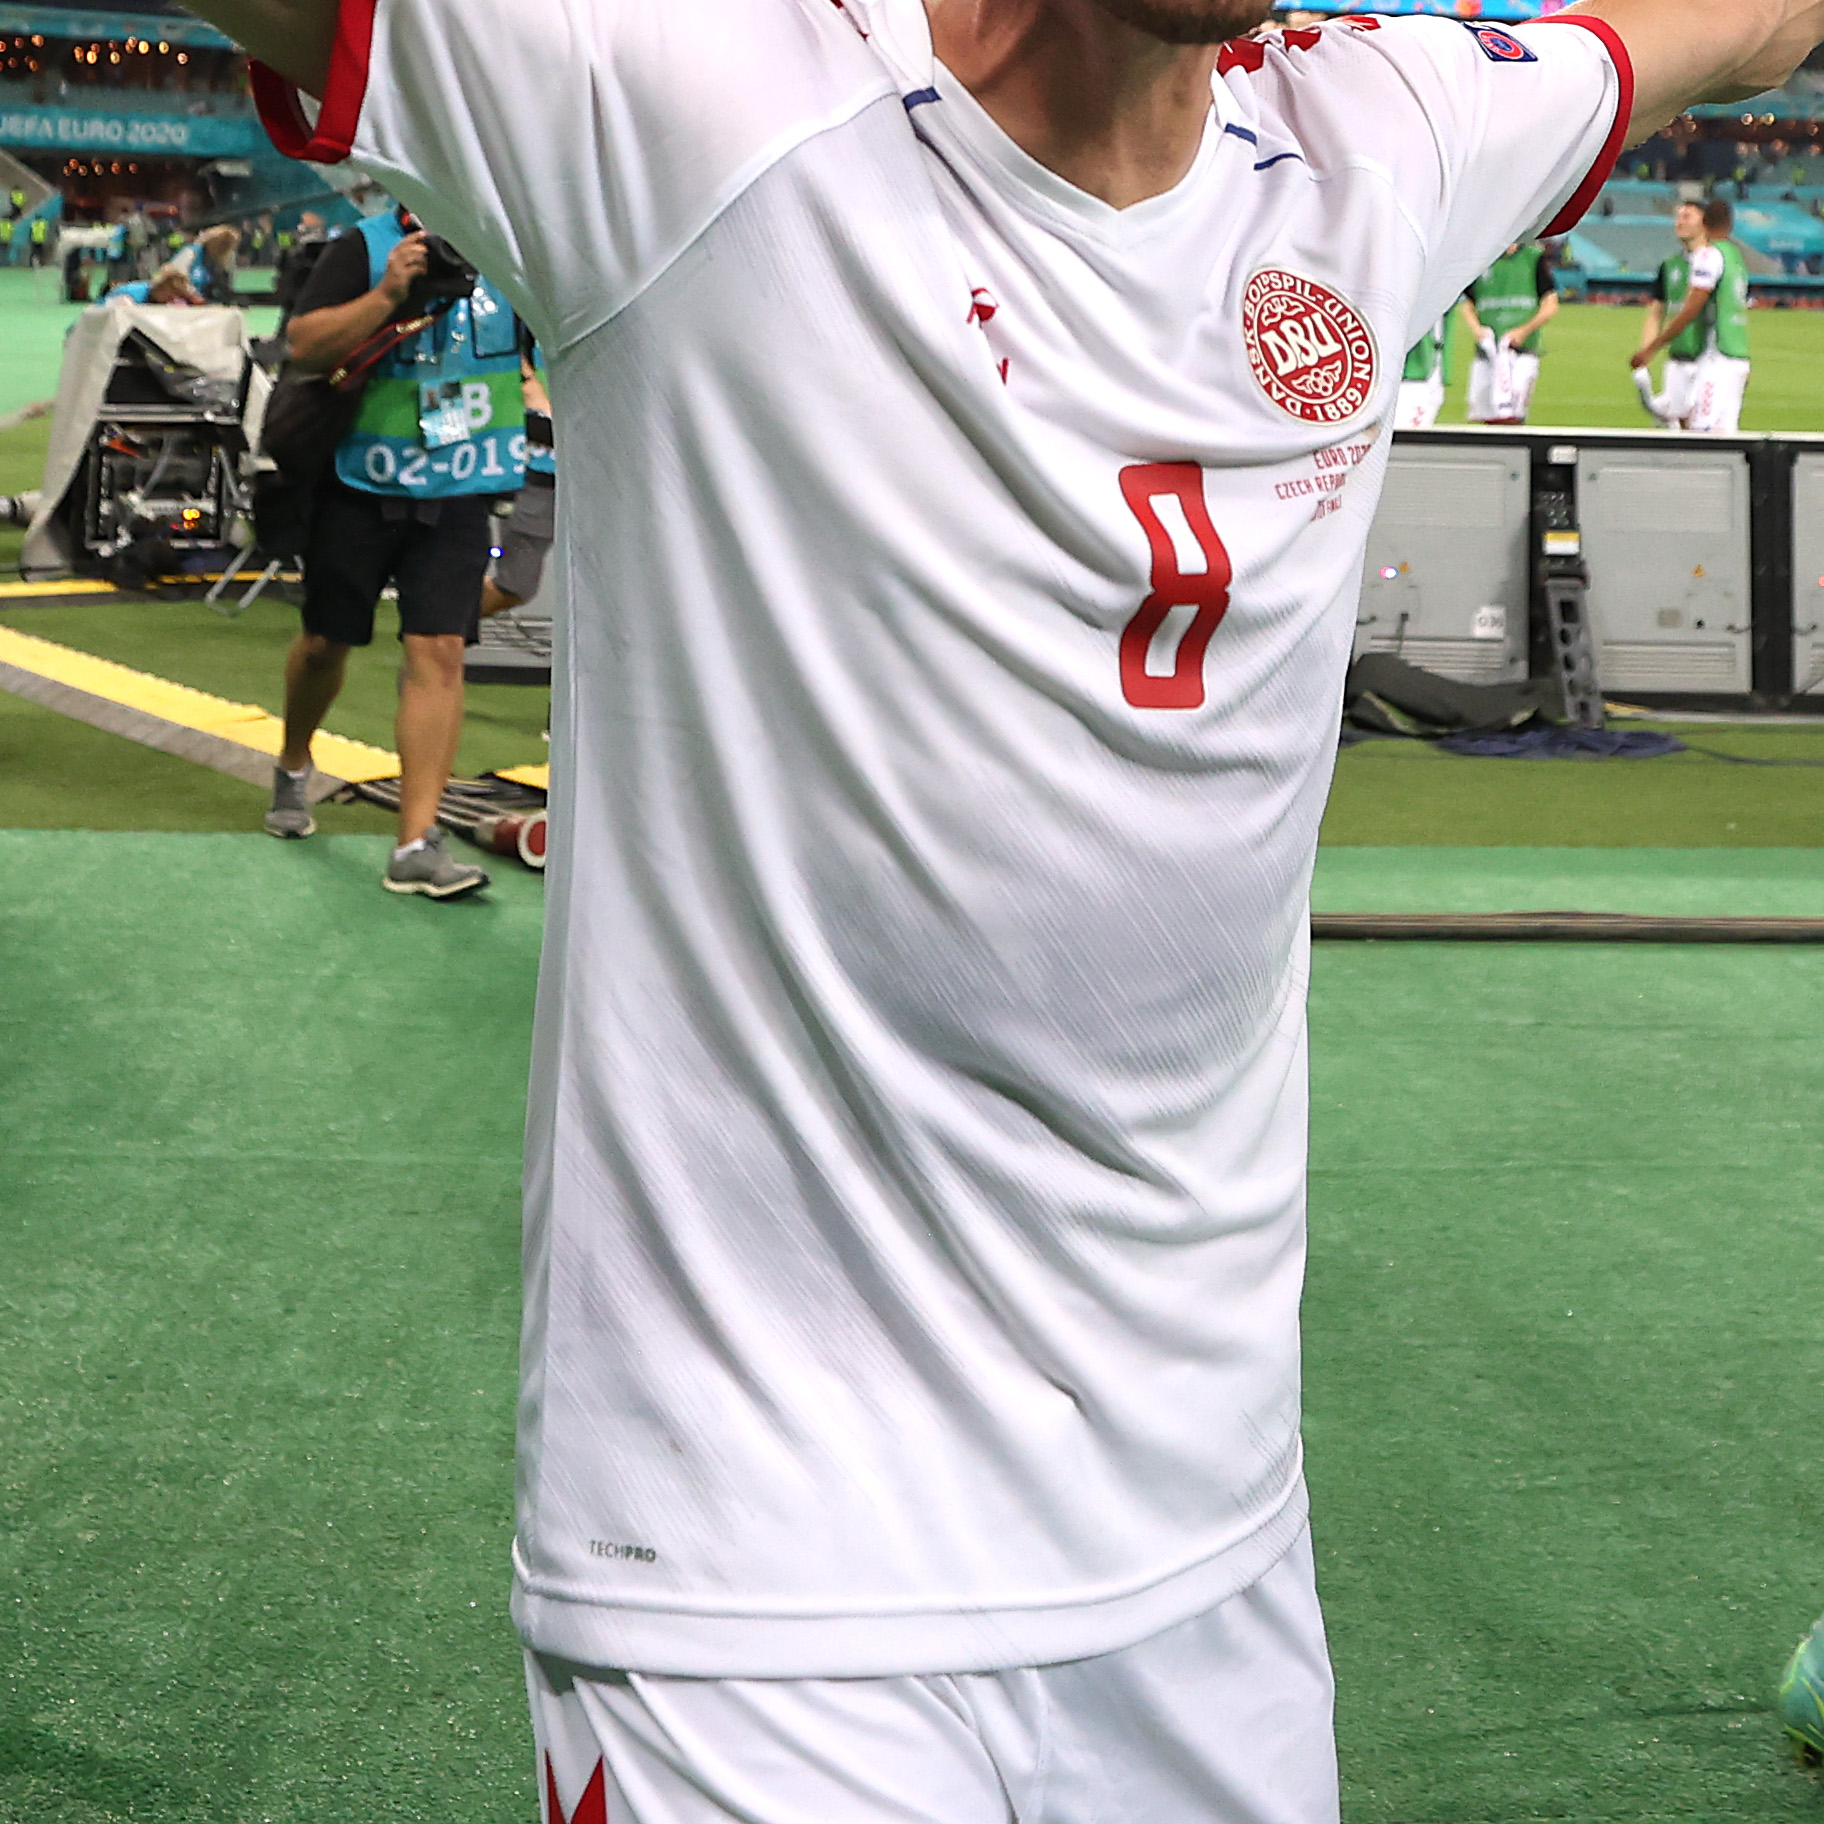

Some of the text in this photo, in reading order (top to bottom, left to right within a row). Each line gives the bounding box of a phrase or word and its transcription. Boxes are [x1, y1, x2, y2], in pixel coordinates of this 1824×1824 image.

[58, 117, 124, 141] EURO
[1260, 312, 1342, 376] DBU
[1245, 328, 1302, 416] DANSK
[1313, 389, 1363, 421] 1889
[1313, 443, 1372, 470] EURO 20
[1275, 478, 1315, 501] CZECH
[1119, 460, 1233, 710] 8
